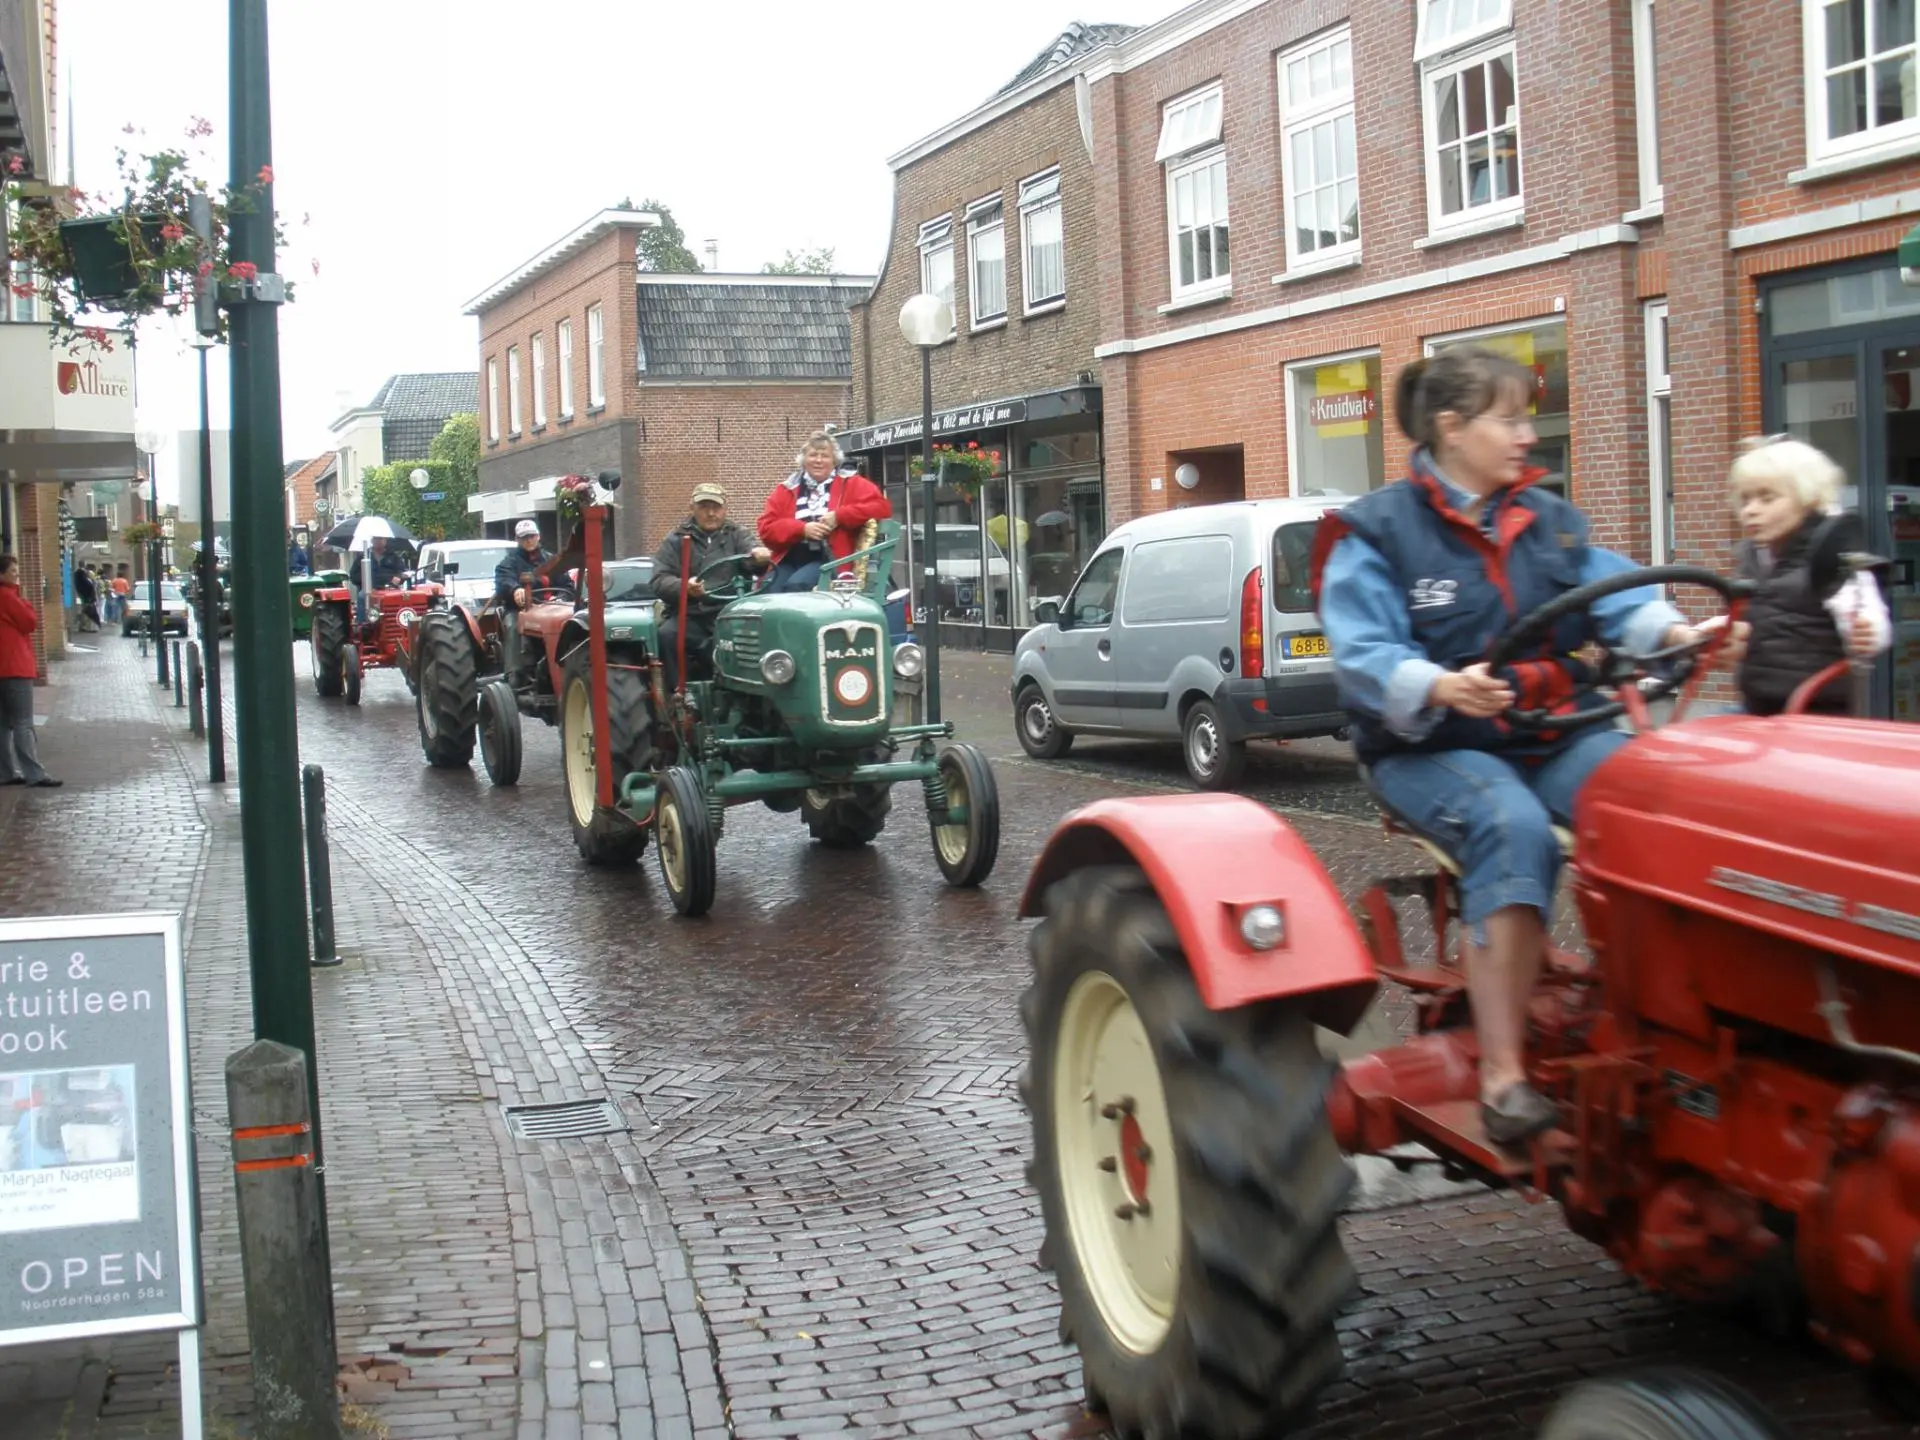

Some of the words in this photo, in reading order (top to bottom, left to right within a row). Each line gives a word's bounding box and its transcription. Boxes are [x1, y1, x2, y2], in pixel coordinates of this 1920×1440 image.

[57, 361, 128, 397] Allure
[973, 408, 981, 424] de
[1316, 395, 1367, 420] Kruidvat
[1296, 638, 1328, 653] 68-B
[67, 951, 92, 979] &
[0, 987, 151, 1018] tuitleen
[0, 1023, 68, 1053] ook
[3, 1172, 54, 1187] Marjan
[60, 1162, 134, 1183] Nagtegaal
[21, 1250, 162, 1293] OPEN
[20, 1291, 130, 1311] Noorderhagen
[137, 1287, 164, 1299] 58a
